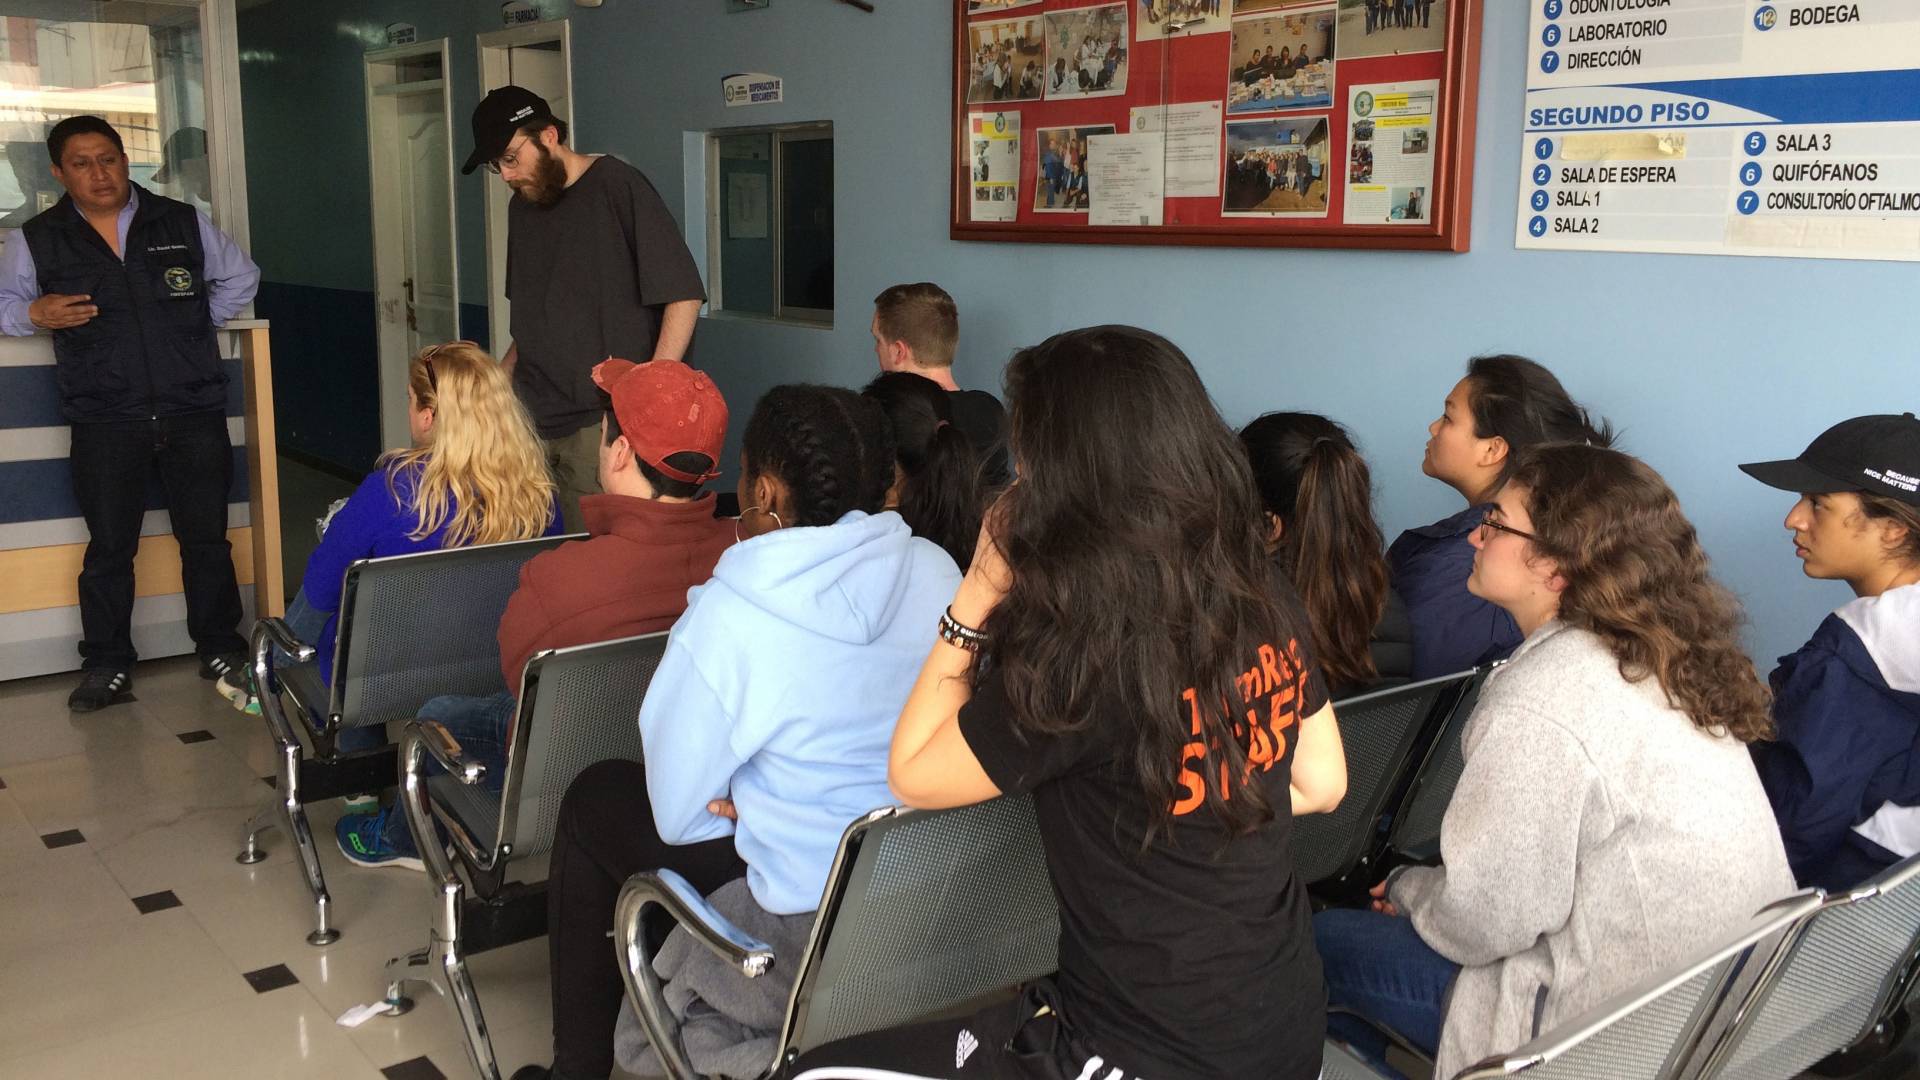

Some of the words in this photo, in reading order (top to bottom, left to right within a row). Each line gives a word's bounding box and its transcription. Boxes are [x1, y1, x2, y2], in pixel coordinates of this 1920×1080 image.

[1789, 5, 1860, 27] BODEGA
[1569, 19, 1667, 42] LABORATORIO
[1567, 46, 1642, 70] DIRECCIÓN
[1529, 104, 1643, 127] SEGUNDO
[1651, 101, 1710, 122] PISO
[1776, 134, 1819, 152] SALA
[1822, 133, 1832, 151] 3
[1561, 167, 1596, 184] SALA
[1599, 167, 1617, 183] DE
[1620, 166, 1677, 183] ESPERA
[1772, 160, 1879, 183] QUIFÓFANOS
[1556, 191, 1591, 207] SALA
[1594, 191, 1601, 206] 1
[1767, 189, 1856, 210] CONSULTORÍO
[1858, 192, 1920, 211] OFTALMO
[1554, 217, 1589, 233] SALA
[1591, 218, 1599, 234] 2
[1863, 468, 1882, 480] NICE
[1881, 476, 1918, 492] MATTERS
